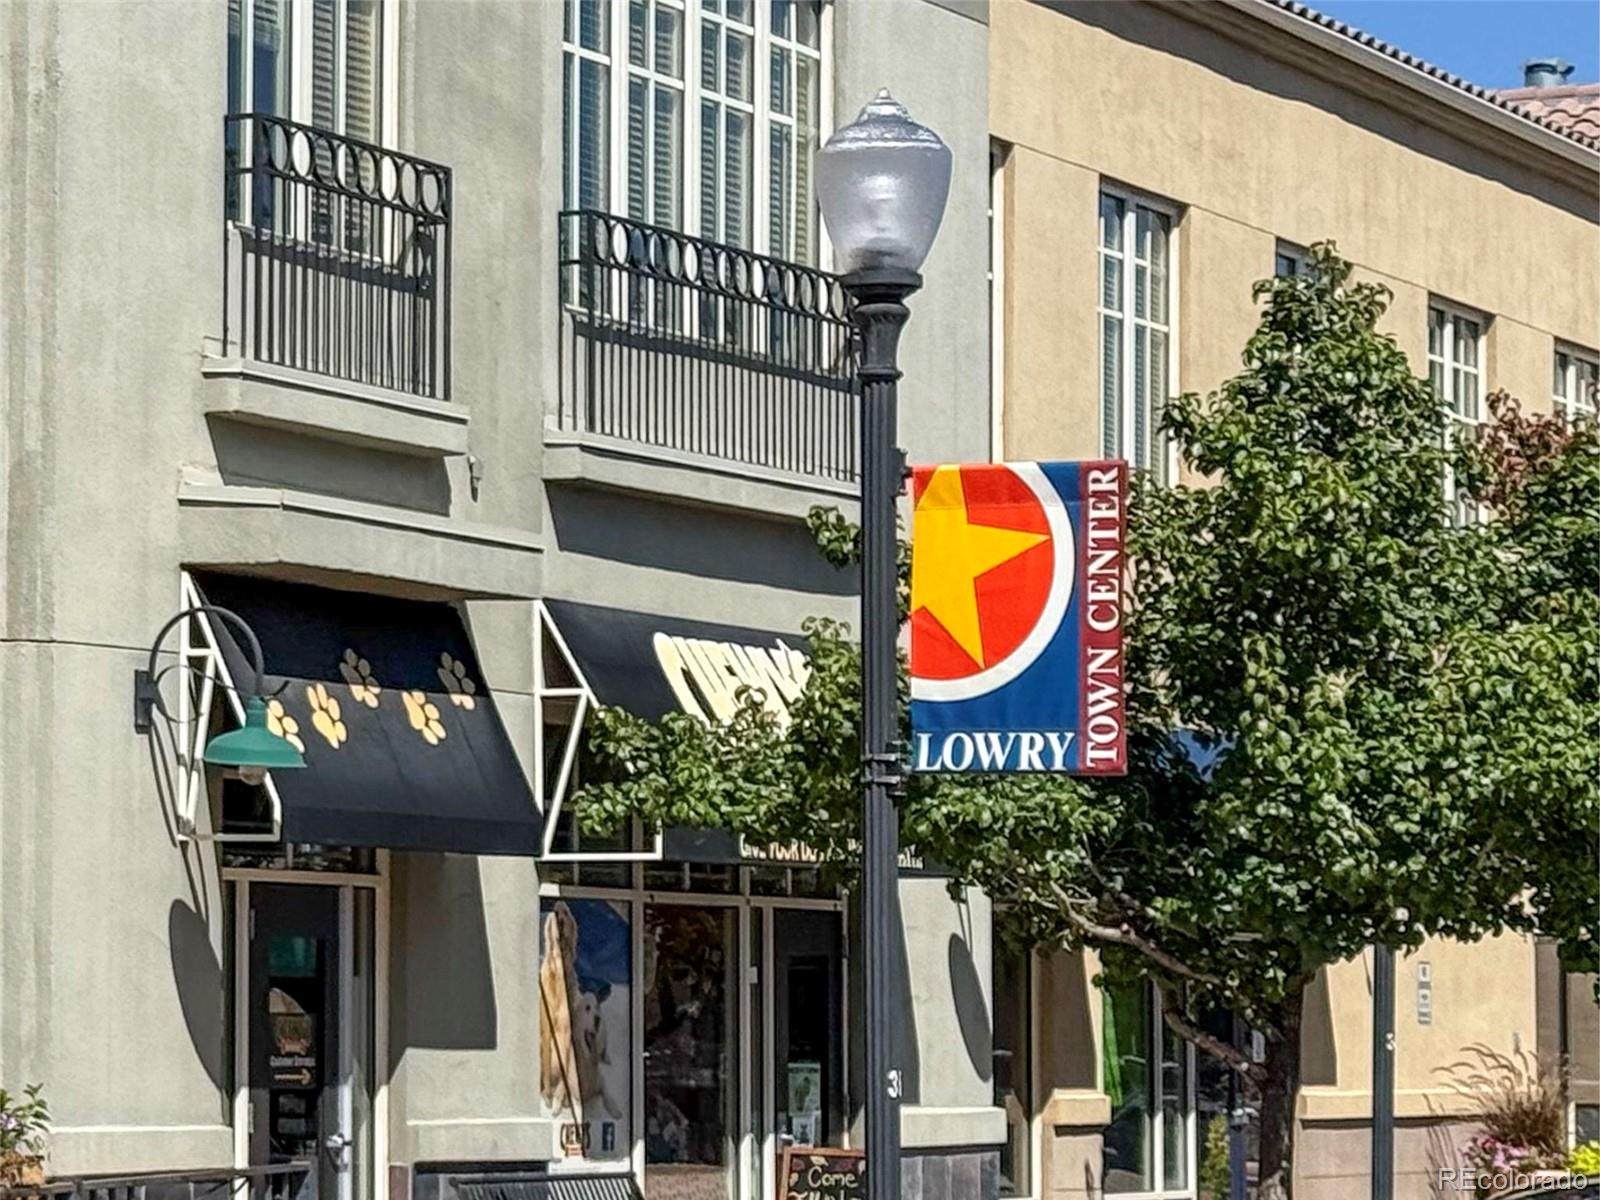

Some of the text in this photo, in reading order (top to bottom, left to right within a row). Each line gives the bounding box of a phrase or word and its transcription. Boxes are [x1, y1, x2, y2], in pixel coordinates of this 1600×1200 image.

[1086, 466, 1121, 768] TOWN CENTER
[916, 731, 1075, 772] LOWRY
[808, 1166, 859, 1188] Come
